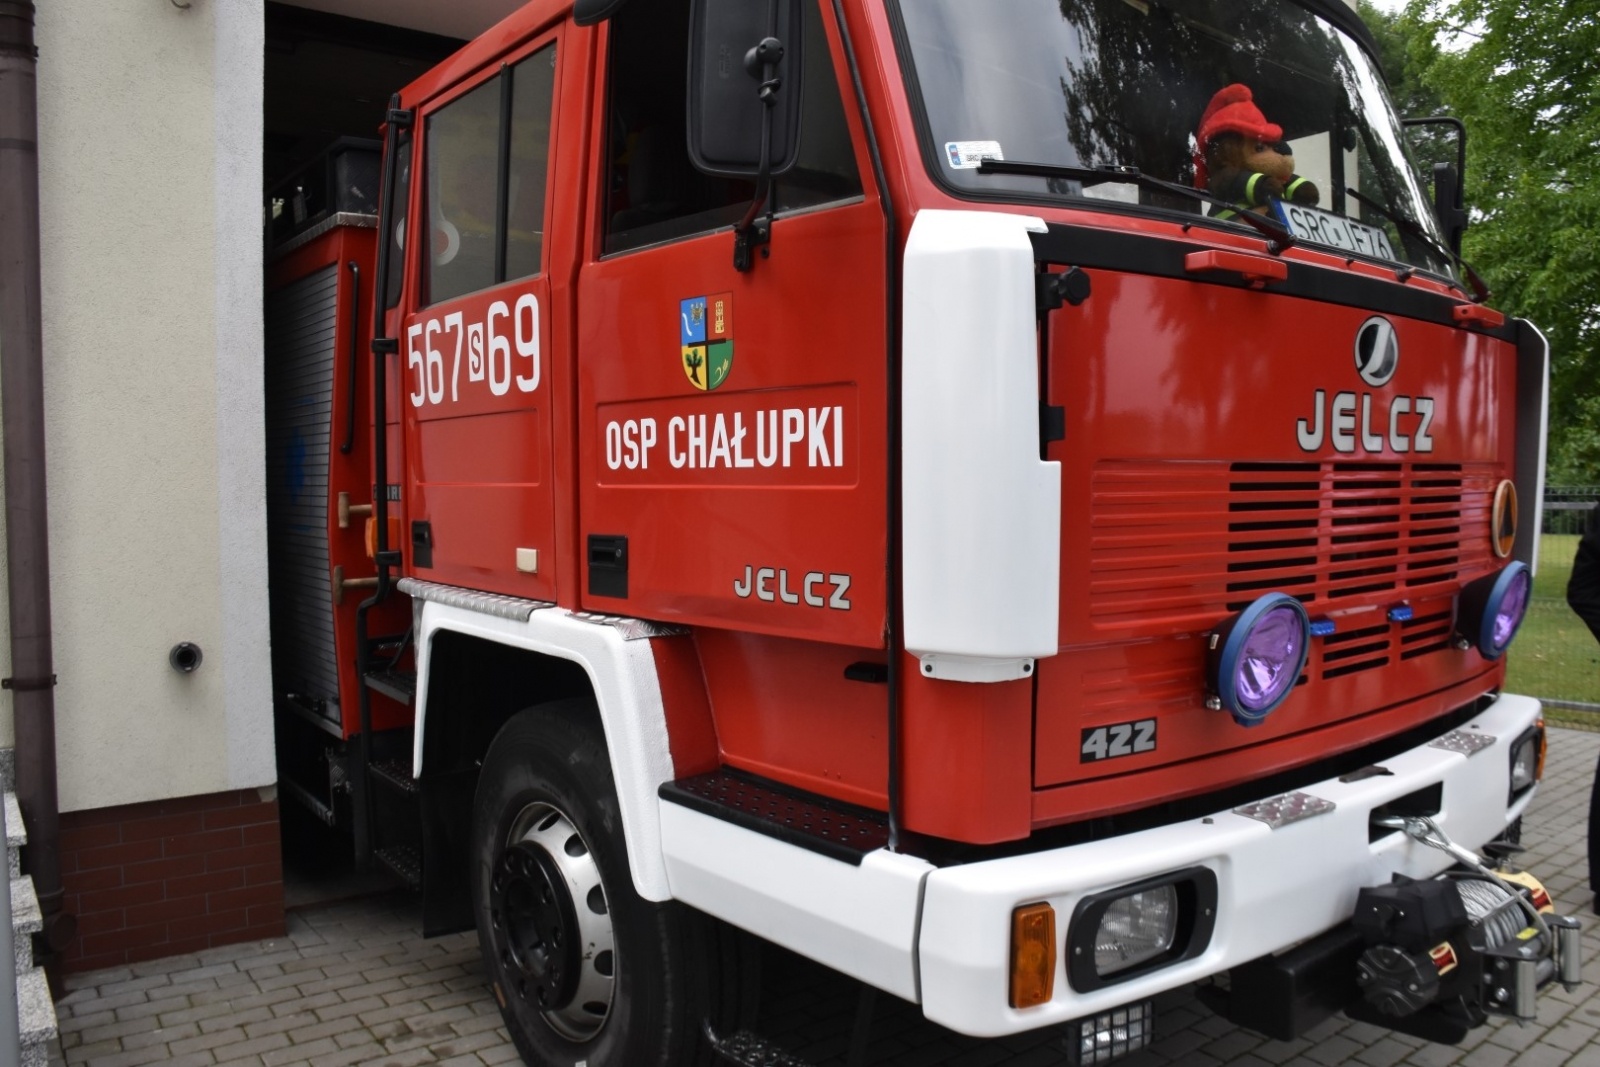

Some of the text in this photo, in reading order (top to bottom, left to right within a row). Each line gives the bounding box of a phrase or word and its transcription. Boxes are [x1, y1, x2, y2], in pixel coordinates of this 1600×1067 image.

[1289, 208, 1340, 246] SRC
[606, 406, 843, 470] OSP CHAŁUPKI
[1297, 389, 1434, 452] JELCZ
[734, 565, 850, 610] JELCZ
[1082, 719, 1155, 759] 422
